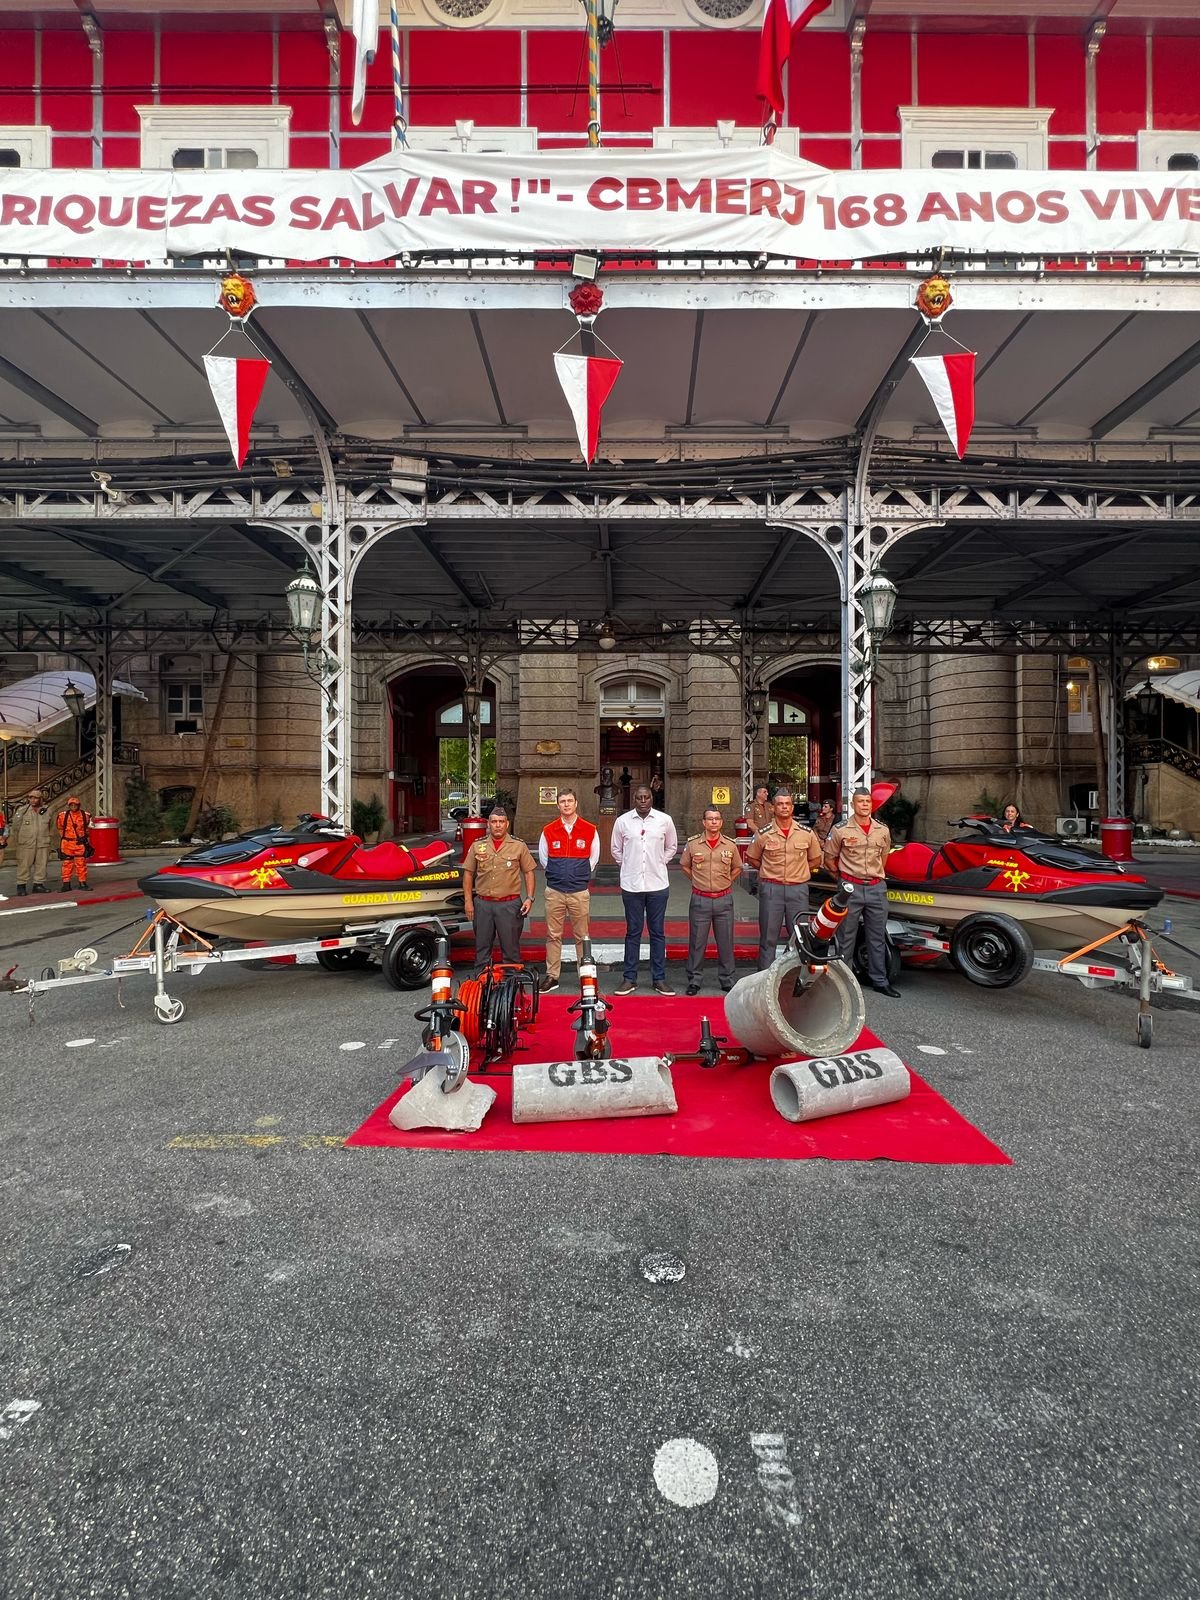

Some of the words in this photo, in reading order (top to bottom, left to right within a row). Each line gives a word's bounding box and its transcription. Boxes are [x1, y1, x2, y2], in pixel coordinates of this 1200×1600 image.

[0, 193, 276, 234] RIQUEZAS
[586, 176, 806, 226] CBMERJ
[817, 193, 908, 230] 168
[916, 190, 1070, 224] ANOS
[1080, 187, 1200, 222] VIVE
[342, 893, 389, 905] GUARDA
[391, 891, 422, 902] VIDAS
[903, 893, 935, 905] VIDAS
[548, 1059, 633, 1087] GBS
[808, 1052, 883, 1088] GBS
